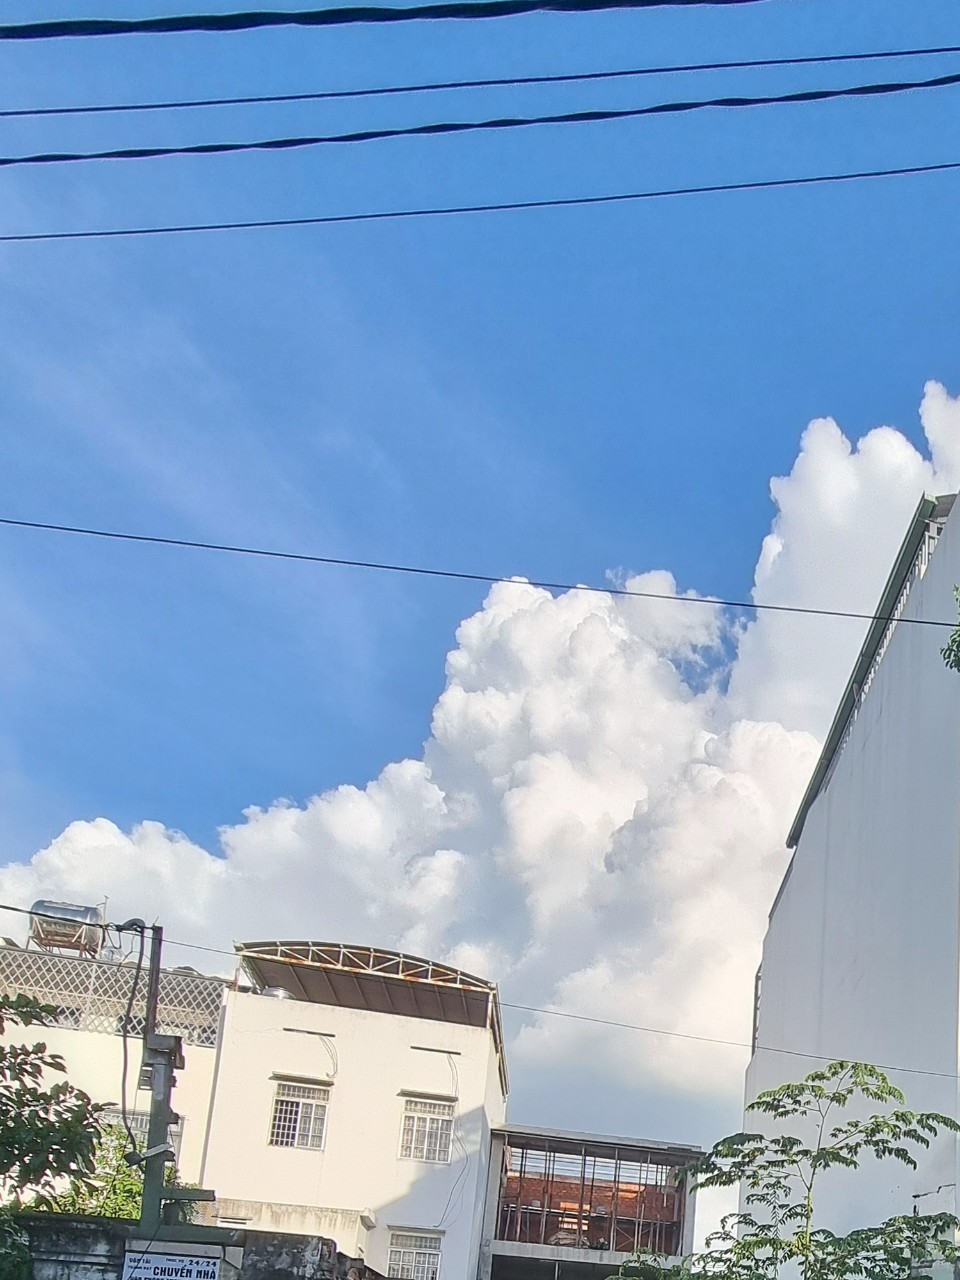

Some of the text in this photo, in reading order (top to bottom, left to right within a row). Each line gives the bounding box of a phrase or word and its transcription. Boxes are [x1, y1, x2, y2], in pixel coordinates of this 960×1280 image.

[188, 1259, 217, 1267] 24/24
[153, 1264, 216, 1280] CHUYỂN NHÀ
